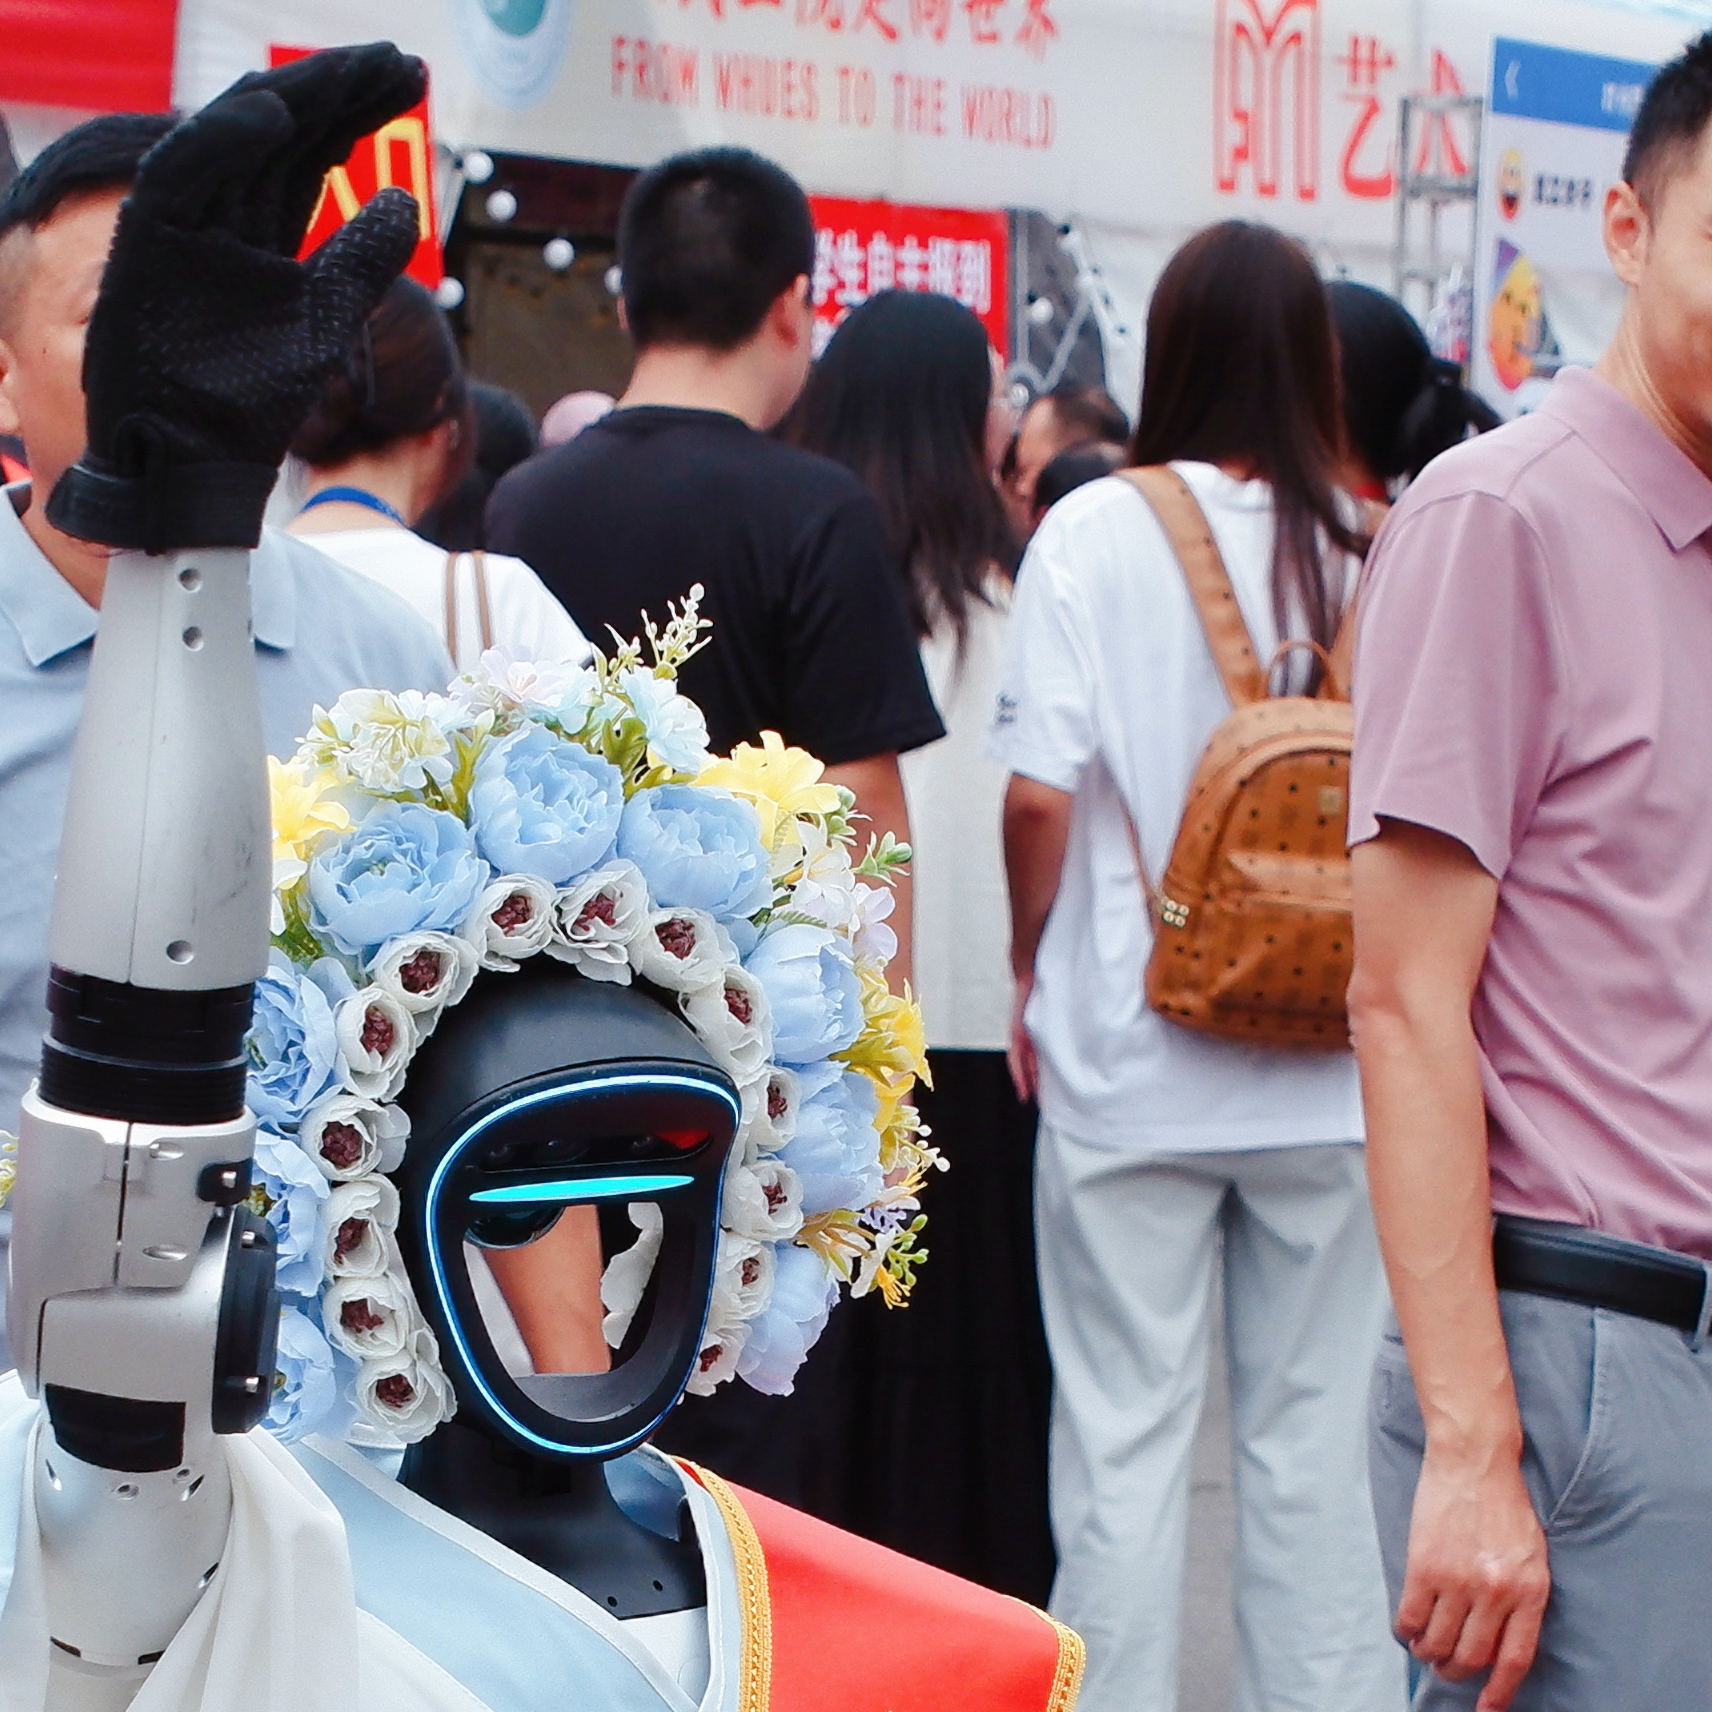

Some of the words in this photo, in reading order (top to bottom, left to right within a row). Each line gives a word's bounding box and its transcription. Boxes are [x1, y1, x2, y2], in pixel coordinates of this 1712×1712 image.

[610, 35, 699, 108] FROM
[838, 66, 876, 128] TO
[891, 73, 947, 137] THE
[960, 83, 1057, 150] WORLD
